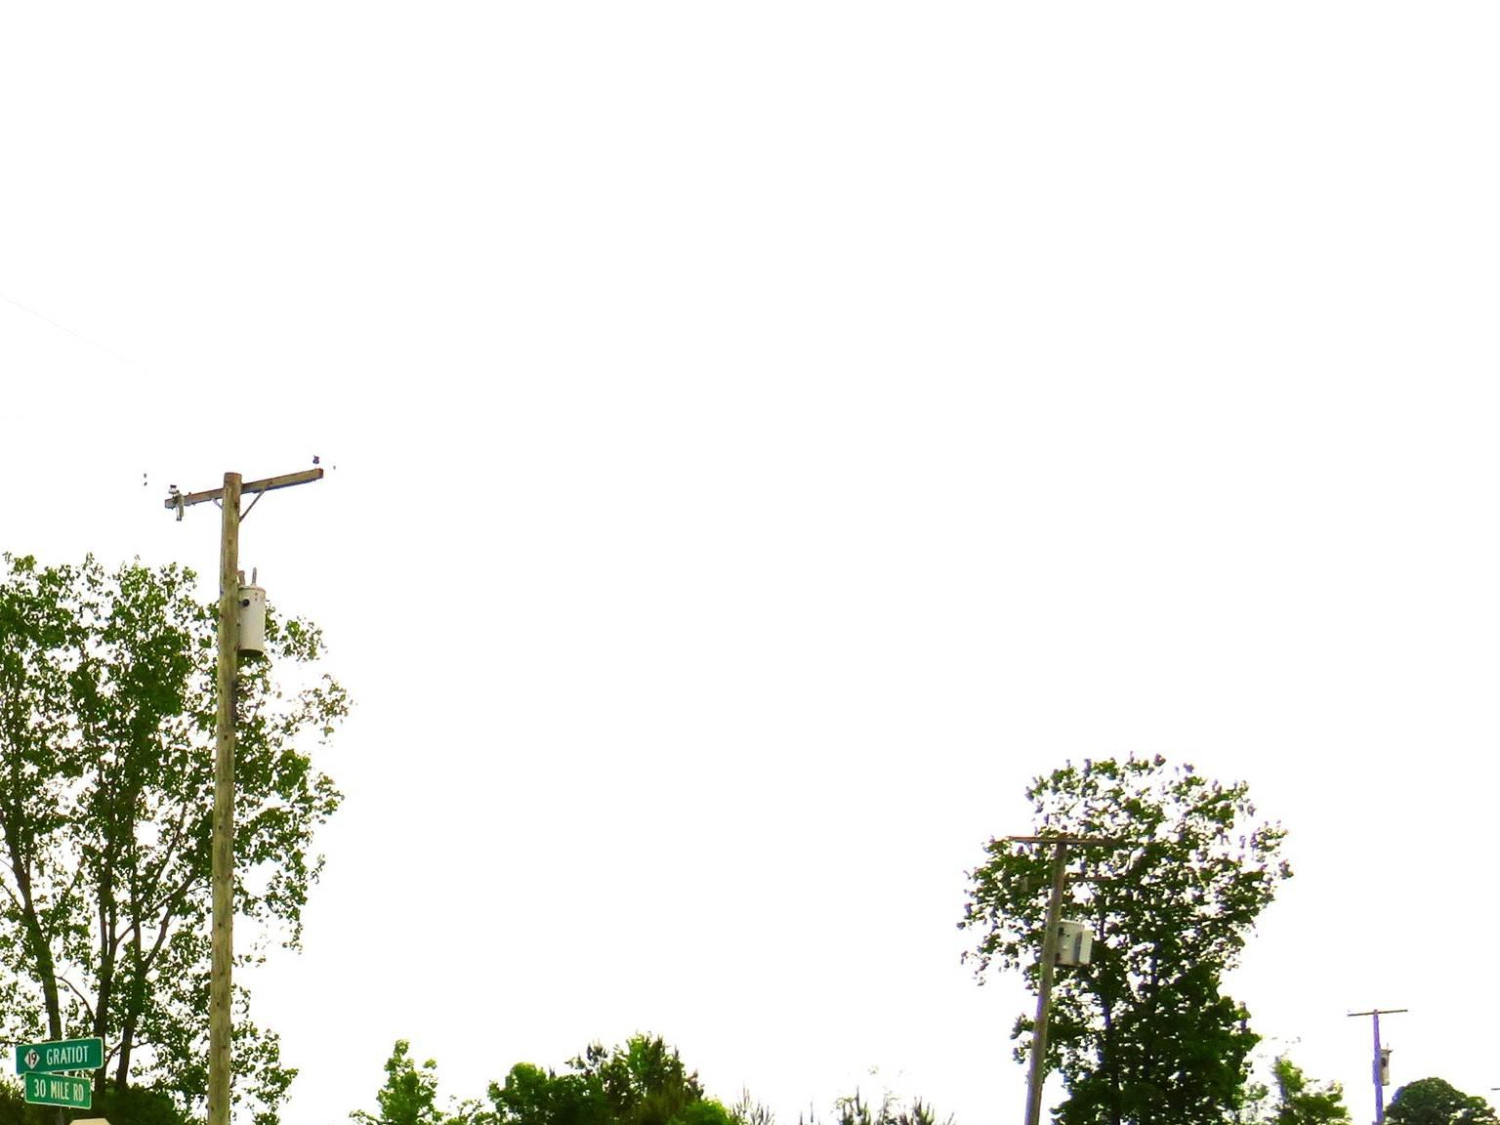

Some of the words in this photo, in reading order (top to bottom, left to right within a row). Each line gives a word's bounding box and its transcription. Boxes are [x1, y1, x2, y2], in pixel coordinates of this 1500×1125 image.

[28, 1052, 37, 1066] 19
[46, 1045, 90, 1066] GRATIOT
[33, 1078, 47, 1098] 30
[50, 1080, 70, 1100] MILE
[73, 1083, 84, 1102] RD
